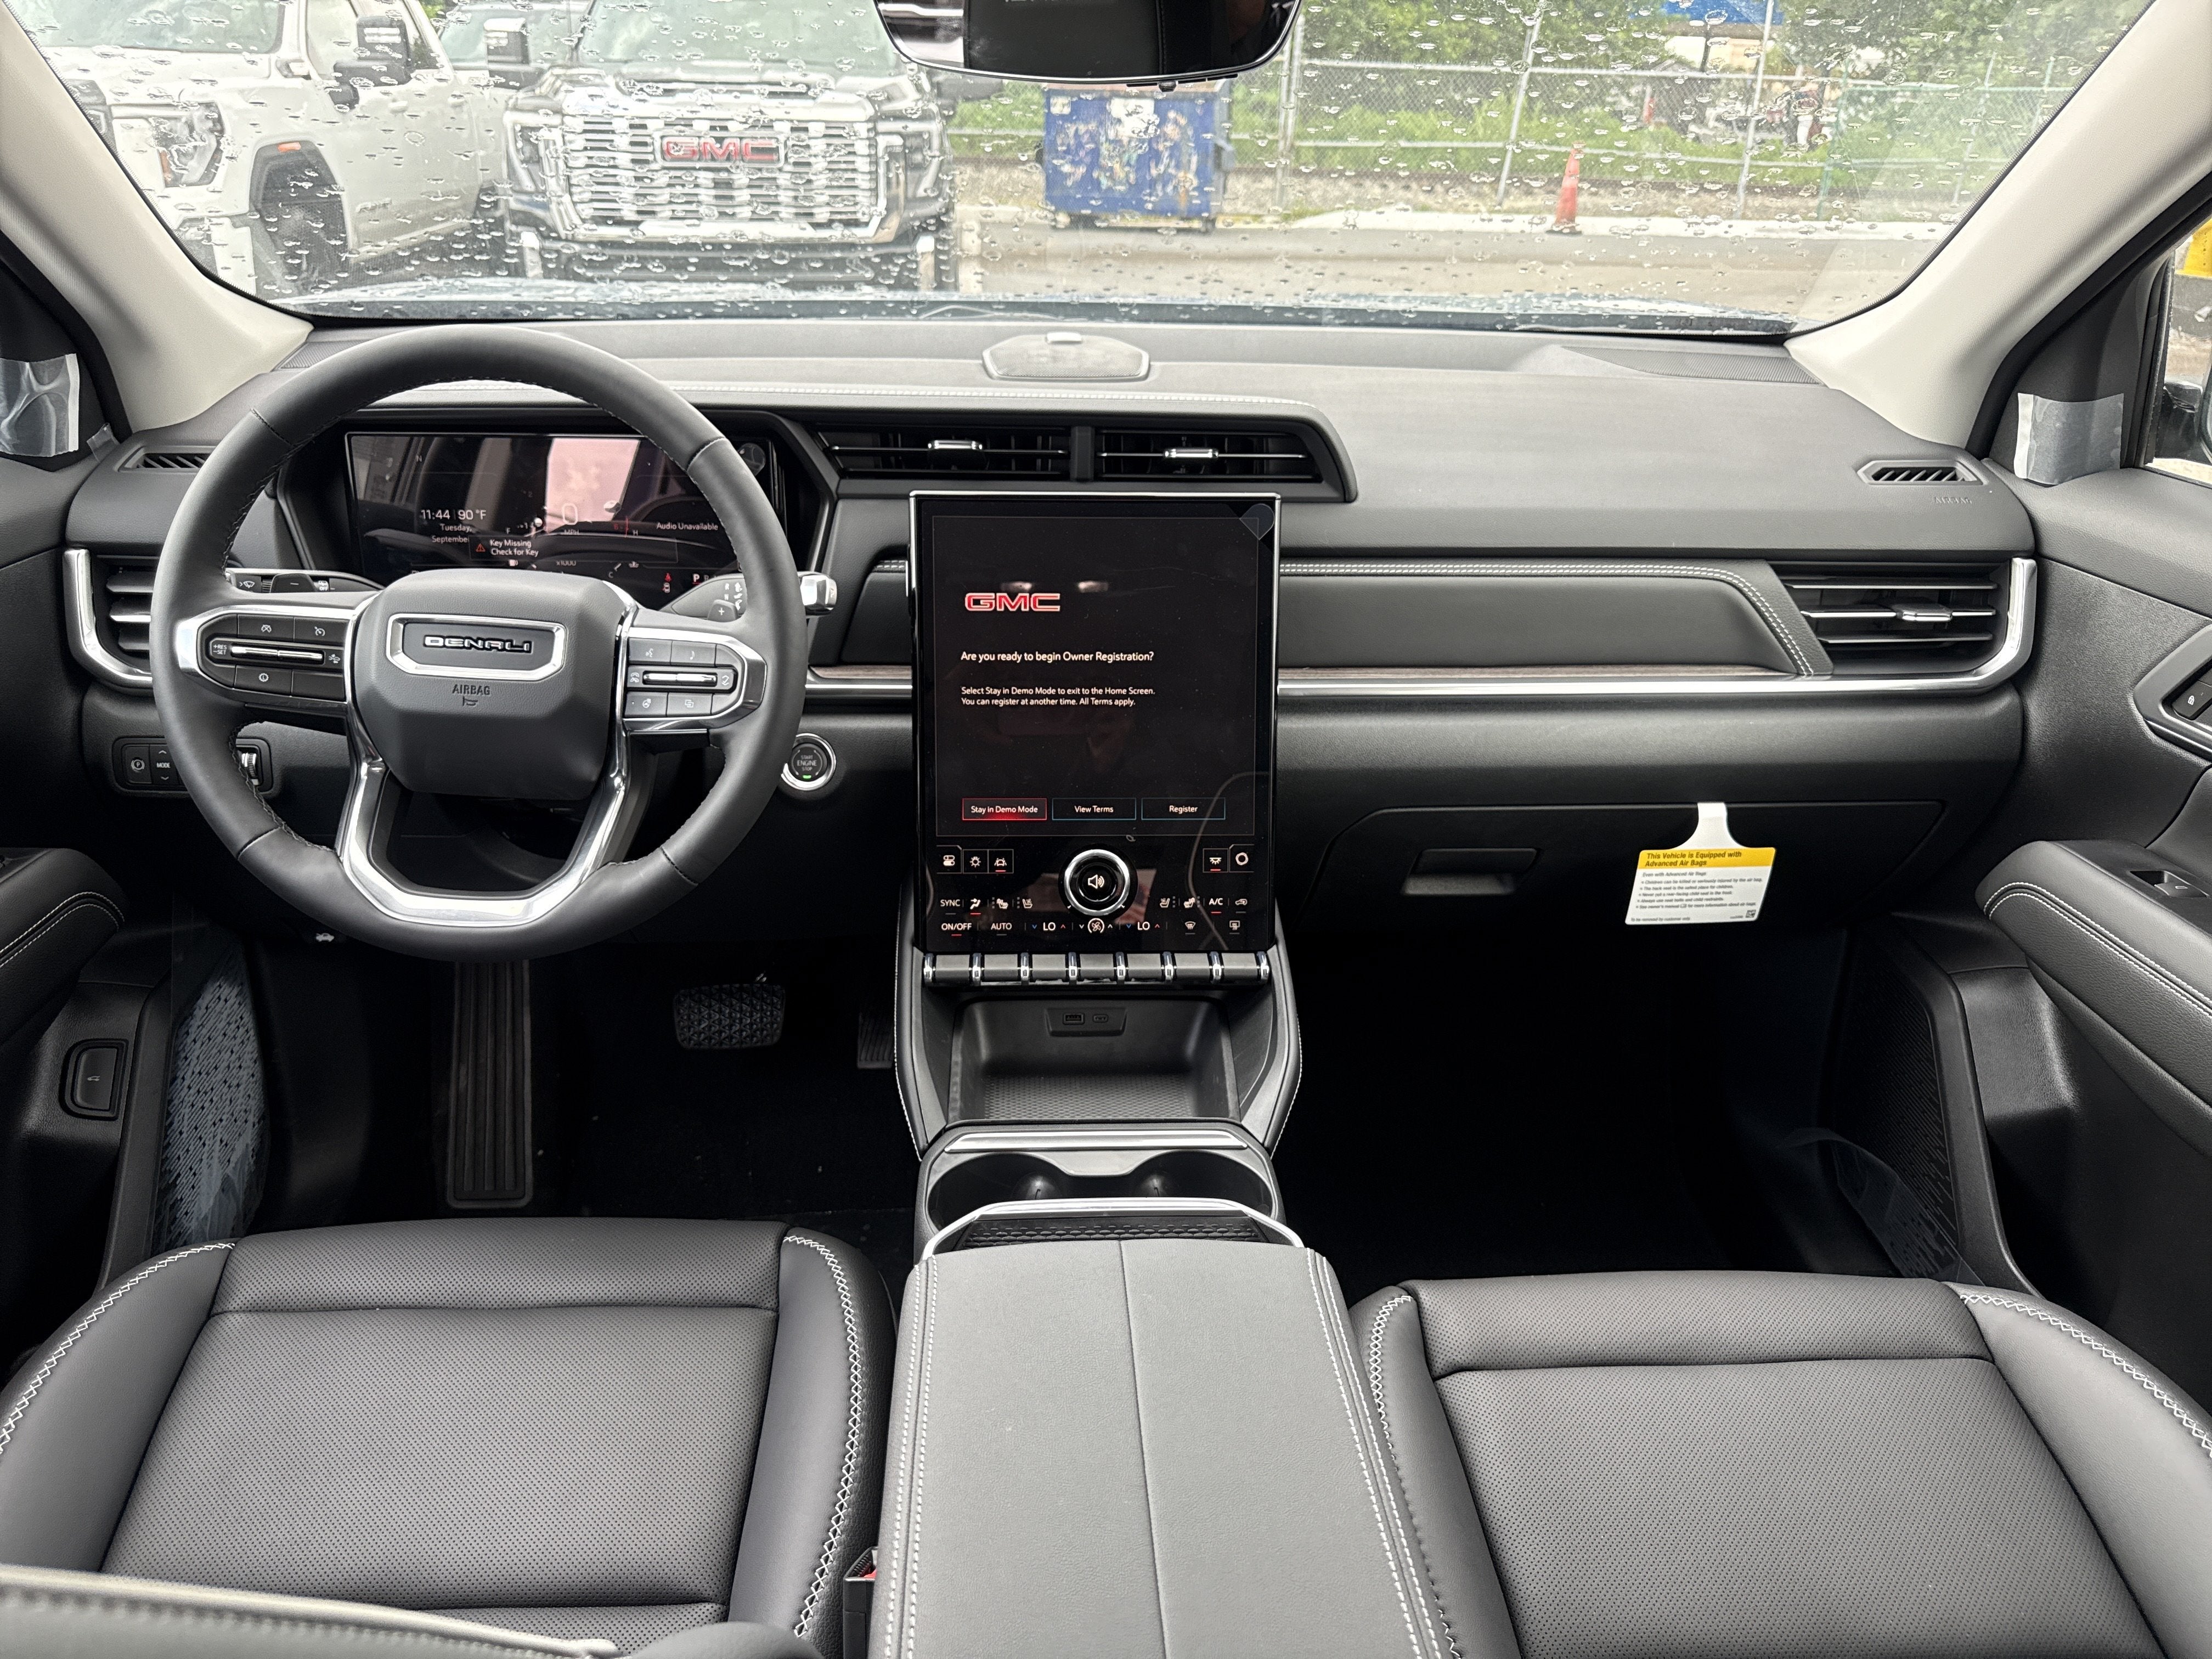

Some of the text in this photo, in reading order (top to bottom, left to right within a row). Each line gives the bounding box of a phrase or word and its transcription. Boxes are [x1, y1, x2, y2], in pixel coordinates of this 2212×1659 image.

[663, 137, 780, 161] GMC
[421, 510, 450, 520] 11:44
[458, 510, 473, 520] 90
[656, 522, 719, 531] Audio Unavailable
[431, 535, 470, 544] Septembe
[489, 539, 532, 548] Key Missing
[525, 549, 539, 557] Key
[965, 592, 1060, 612] GMC
[424, 636, 531, 653] DENALI
[961, 651, 1154, 663] Are you ready to begin Owner Registration?
[452, 685, 490, 695] AIRBAG
[961, 686, 984, 695] Select
[985, 686, 1001, 696] Stay
[1035, 686, 1056, 695] Mode
[1128, 686, 1155, 695] Screen.
[961, 697, 975, 706] You
[991, 698, 1020, 707] register
[1029, 697, 1058, 706] another
[1059, 697, 1078, 706] time.
[1079, 697, 1089, 706] All
[1090, 697, 1113, 706] Terms
[1114, 697, 1136, 707] apply.
[970, 805, 986, 815] Stay
[995, 805, 1017, 814] Demo
[1018, 805, 1038, 814] Mode
[1092, 805, 1114, 813] Terms
[1169, 805, 1198, 814] Register
[940, 899, 961, 907] SYNC
[1209, 898, 1223, 906] A/C
[941, 922, 972, 931] ON/OFF
[990, 922, 1012, 930] AUTO
[1043, 922, 1056, 931] LO
[1137, 921, 1150, 930] LO
